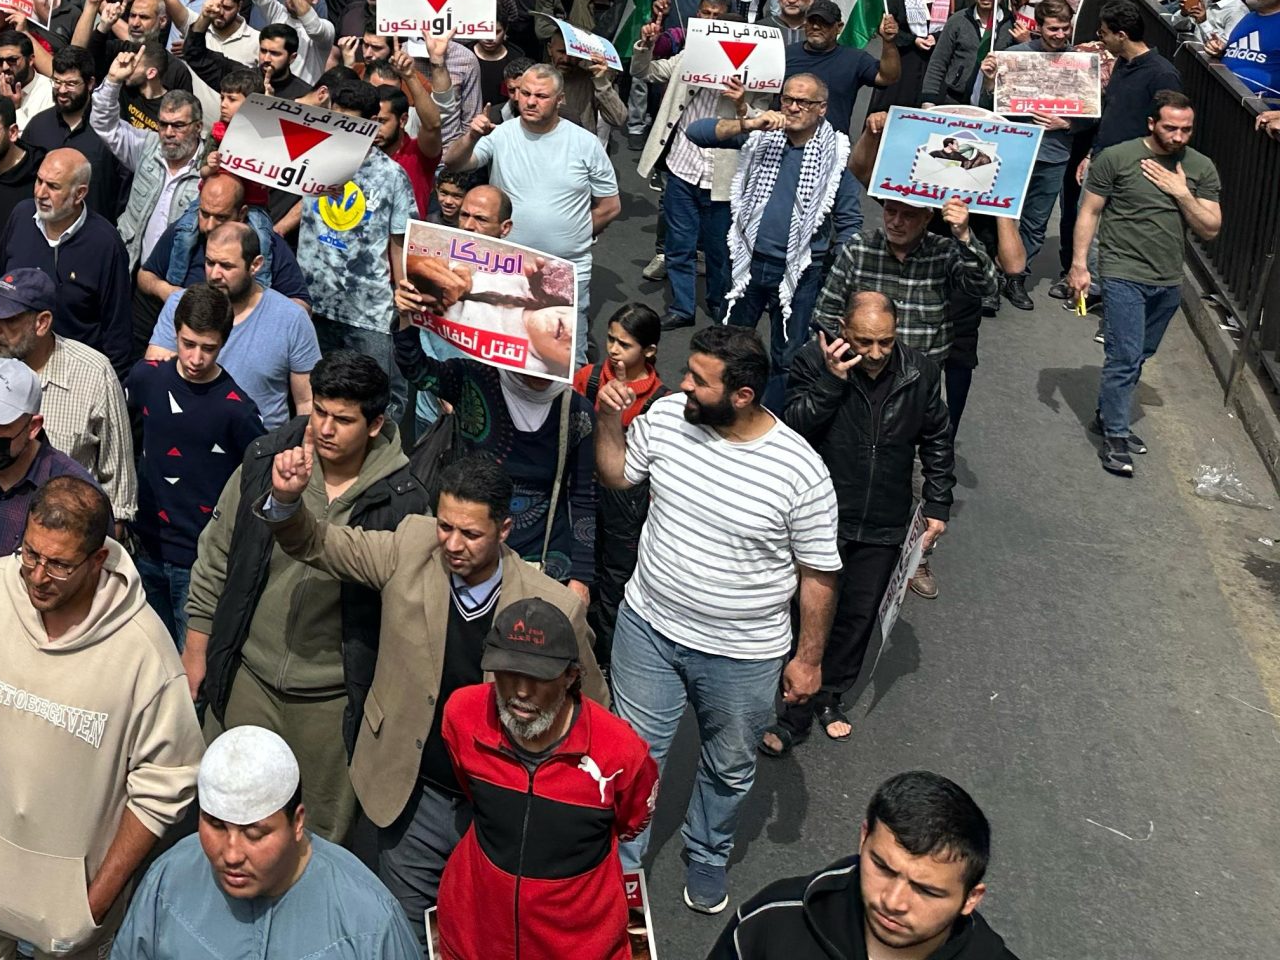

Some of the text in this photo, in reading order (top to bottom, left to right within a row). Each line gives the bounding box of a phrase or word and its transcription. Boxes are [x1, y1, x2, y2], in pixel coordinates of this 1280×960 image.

[379, 17, 417, 31] نكون
[432, 7, 452, 35] أو
[456, 20, 494, 35] نكون
[706, 22, 780, 42] الأمة في خطر
[681, 71, 717, 84] نكون
[748, 79, 782, 89] نكون
[1016, 100, 1080, 113] تبيد غزة
[266, 100, 378, 137] الأمة في خطر
[948, 119, 982, 132] العالم
[984, 122, 1001, 136] إلى
[1005, 124, 1034, 137] رسالة
[220, 149, 341, 196] كون أو لا نكون
[880, 178, 1016, 209] كلنا المقاومة
[449, 238, 524, 276] امريكا
[439, 323, 478, 351] أطفال
[481, 340, 524, 362] تقتل
